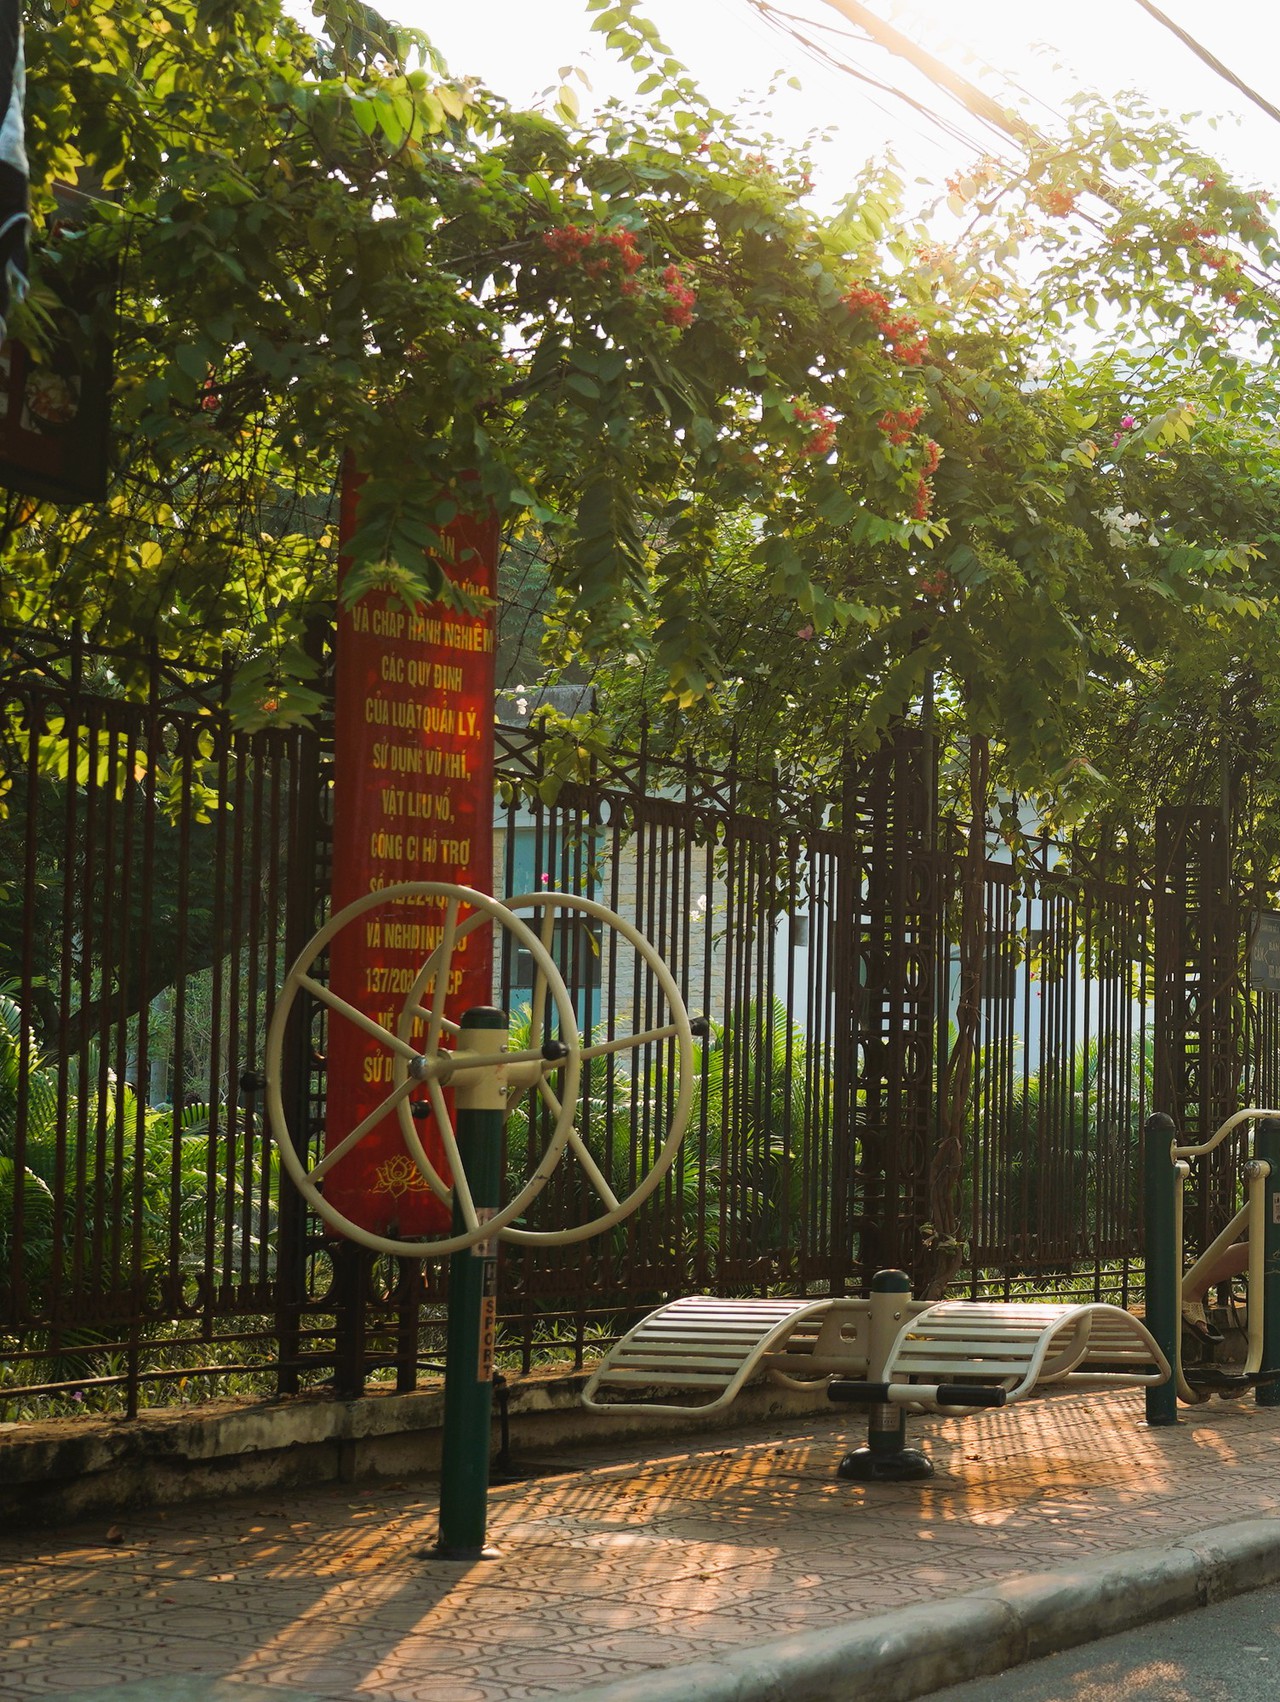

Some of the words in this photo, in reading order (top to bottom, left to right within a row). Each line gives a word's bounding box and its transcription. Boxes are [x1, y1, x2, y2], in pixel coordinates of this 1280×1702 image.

[352, 602, 369, 632] VÀ
[408, 612, 441, 646] HÀNH
[444, 621, 494, 654] NGHIÊM
[381, 651, 404, 683] CÁC
[407, 659, 431, 688] QUY
[433, 664, 463, 696] ĐỊNH
[365, 690, 389, 724] CỦA
[392, 698, 422, 734] LUẬT
[423, 699, 455, 735] QUẢN
[458, 706, 481, 740] LÝ,
[373, 736, 388, 769] SỬ
[425, 746, 442, 776] VŨ
[382, 784, 405, 821] VẬT
[407, 791, 432, 819] LIU
[371, 828, 403, 860] CÔNG
[406, 835, 420, 862] C
[441, 838, 470, 871] TRỢ
[366, 917, 381, 948] VÀ
[384, 923, 411, 954] NGH
[363, 1048, 384, 1083] SỬ
